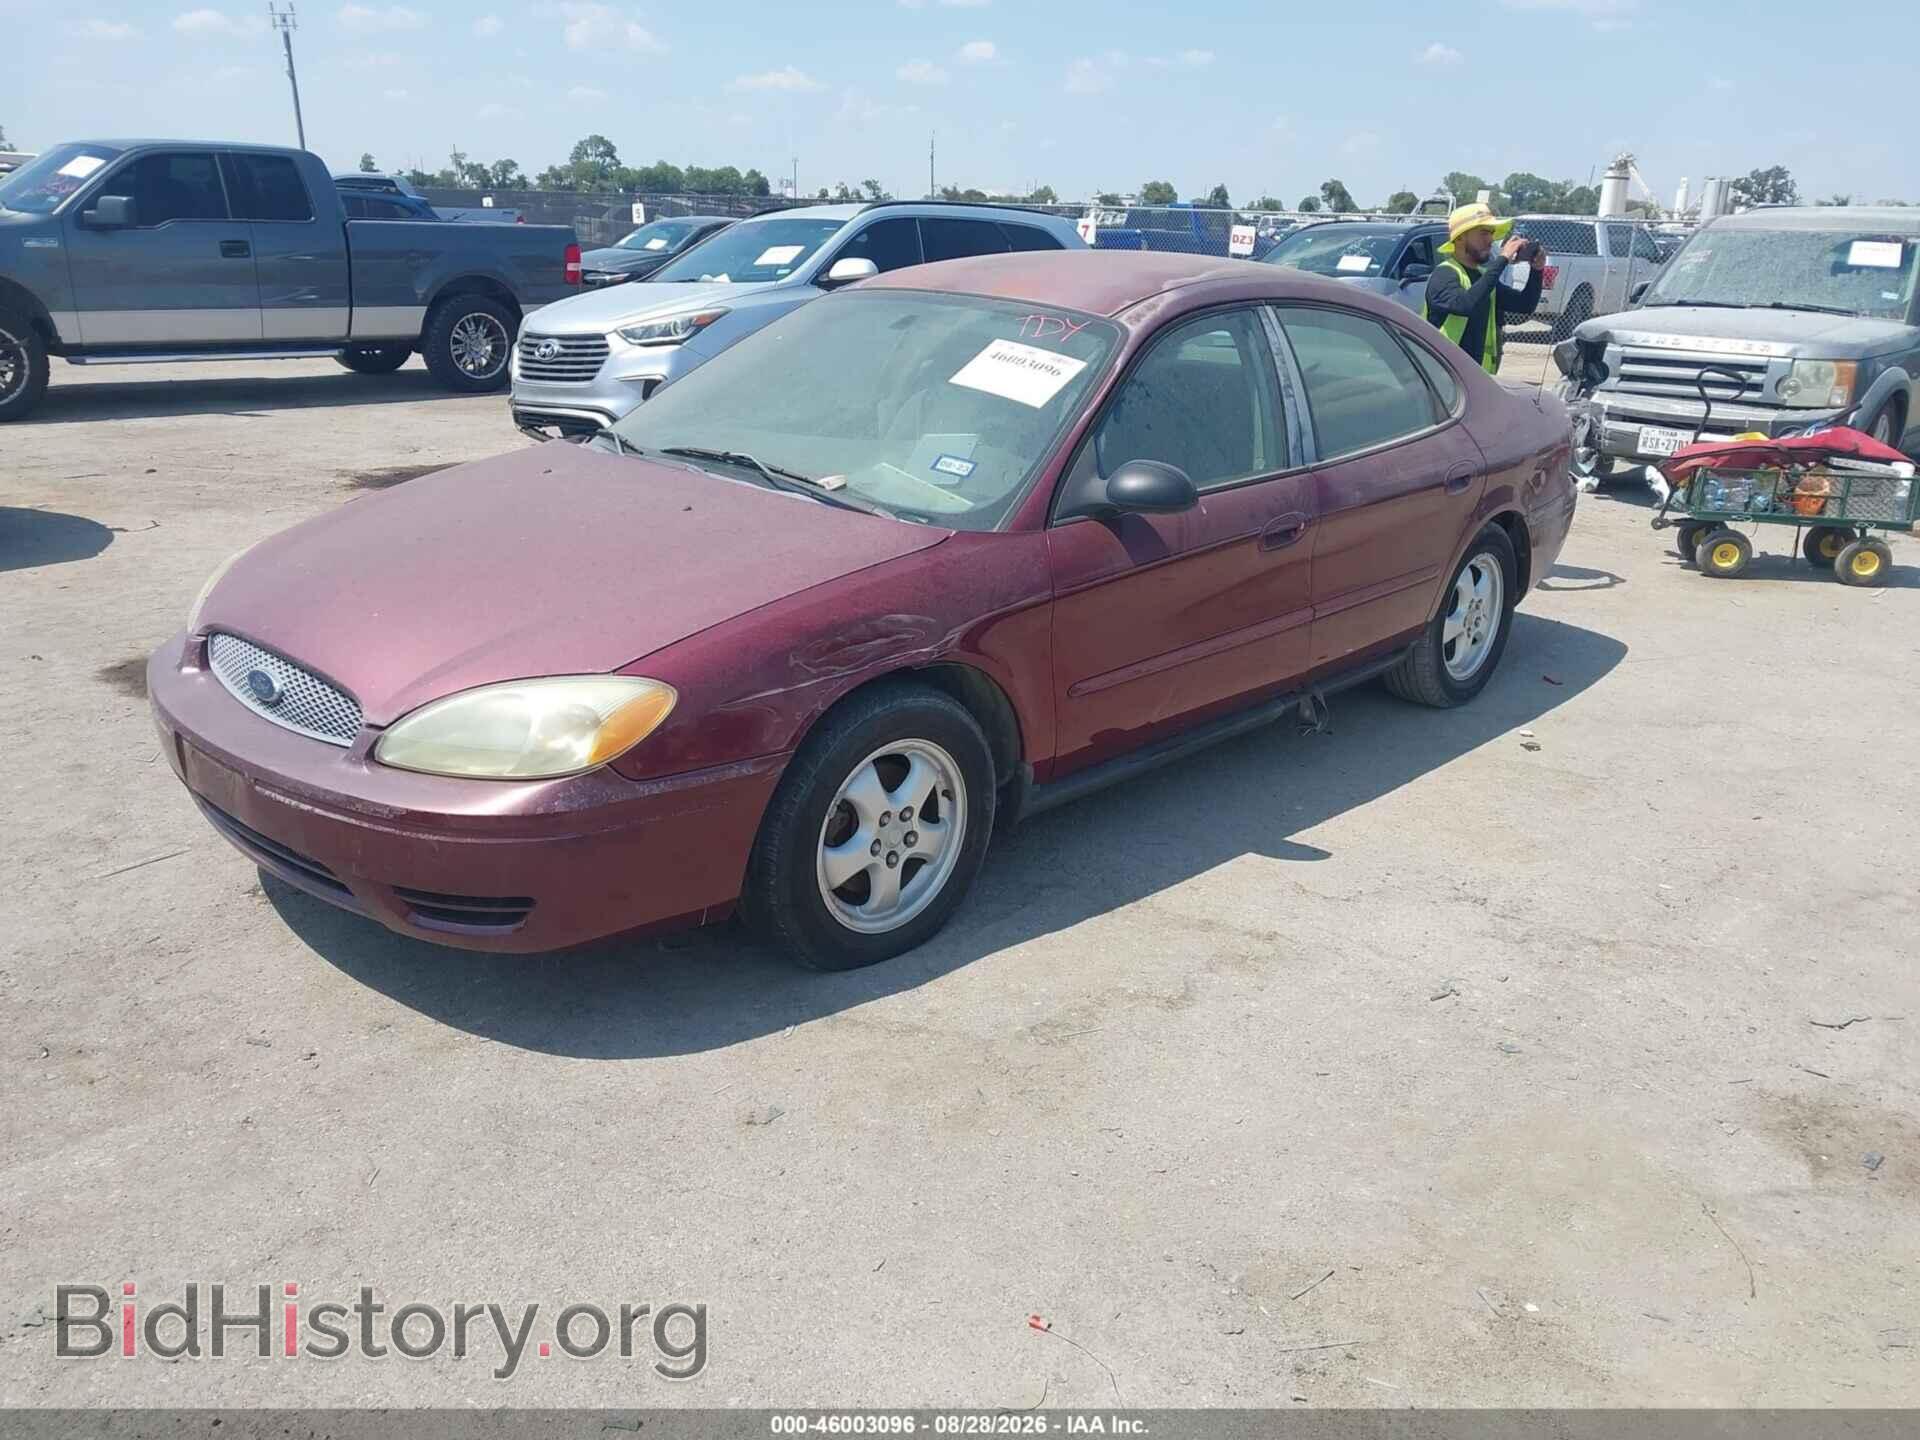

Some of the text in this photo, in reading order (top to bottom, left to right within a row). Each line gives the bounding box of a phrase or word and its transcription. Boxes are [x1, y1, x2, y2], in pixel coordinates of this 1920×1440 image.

[1081, 224, 1090, 238] 7
[1232, 233, 1254, 246] DZ3
[1016, 314, 1092, 342] TDY
